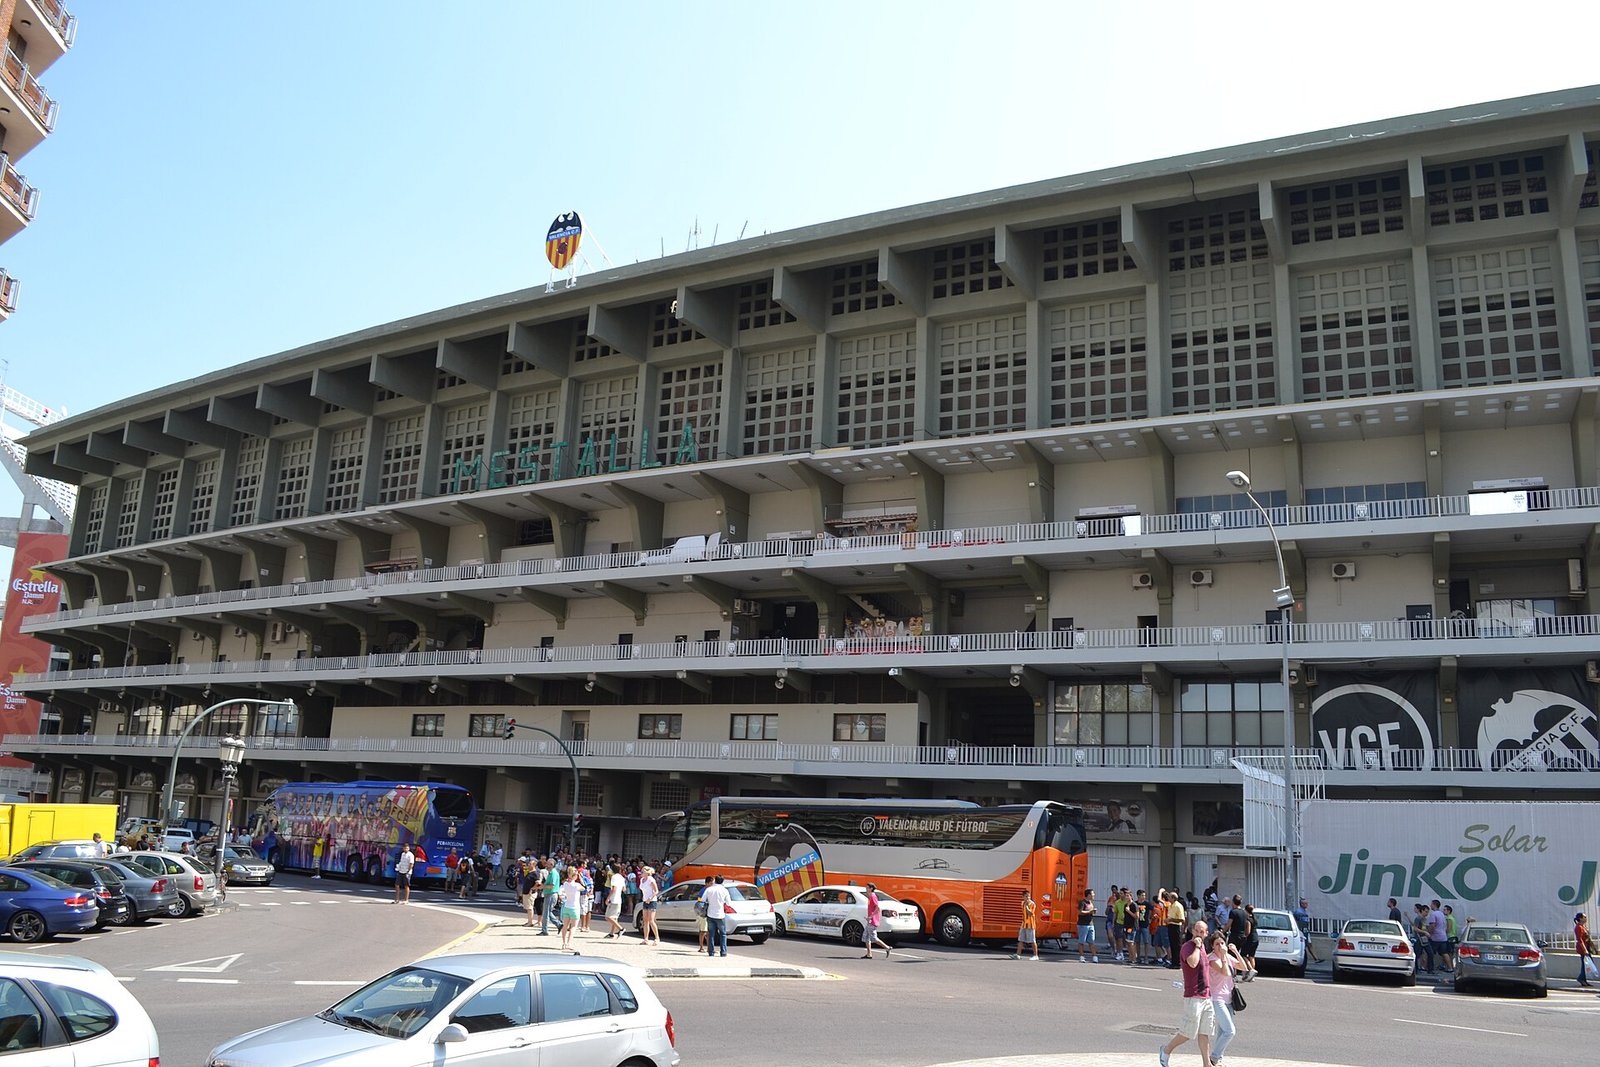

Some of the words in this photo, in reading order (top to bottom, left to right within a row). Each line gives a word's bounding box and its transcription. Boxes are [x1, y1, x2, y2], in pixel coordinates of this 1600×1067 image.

[453, 422, 698, 492] MESTALLA
[12, 577, 59, 593] Estrella
[1318, 722, 1401, 771] VCF
[878, 818, 918, 831] VALENCIA
[920, 820, 940, 832] CLUB
[943, 821, 954, 832] DE
[956, 818, 989, 833] FÚTBOL
[1458, 824, 1549, 854] Solar
[758, 862, 800, 885] VALENCIA
[801, 853, 817, 866] C.F.
[1318, 848, 1500, 902] JinKO
[1557, 860, 1600, 906] J
